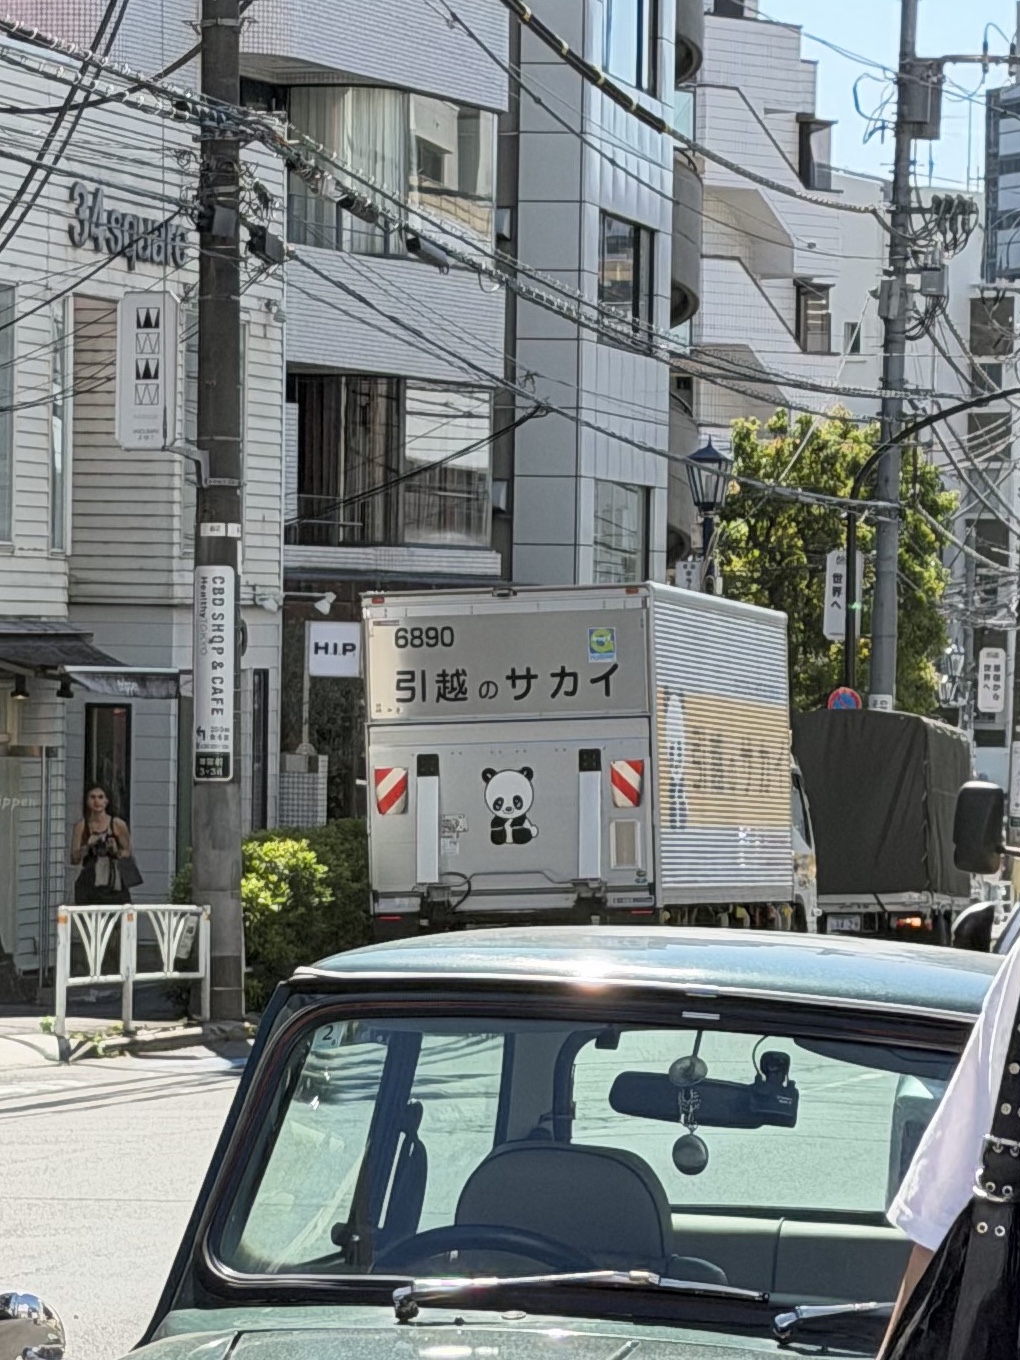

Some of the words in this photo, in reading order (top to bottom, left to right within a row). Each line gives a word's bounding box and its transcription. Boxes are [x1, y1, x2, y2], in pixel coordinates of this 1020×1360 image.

[211, 576, 226, 607] CBD
[394, 626, 455, 649] 6890
[210, 676, 225, 716] CAFE
[395, 662, 619, 703] 引越のサカイ
